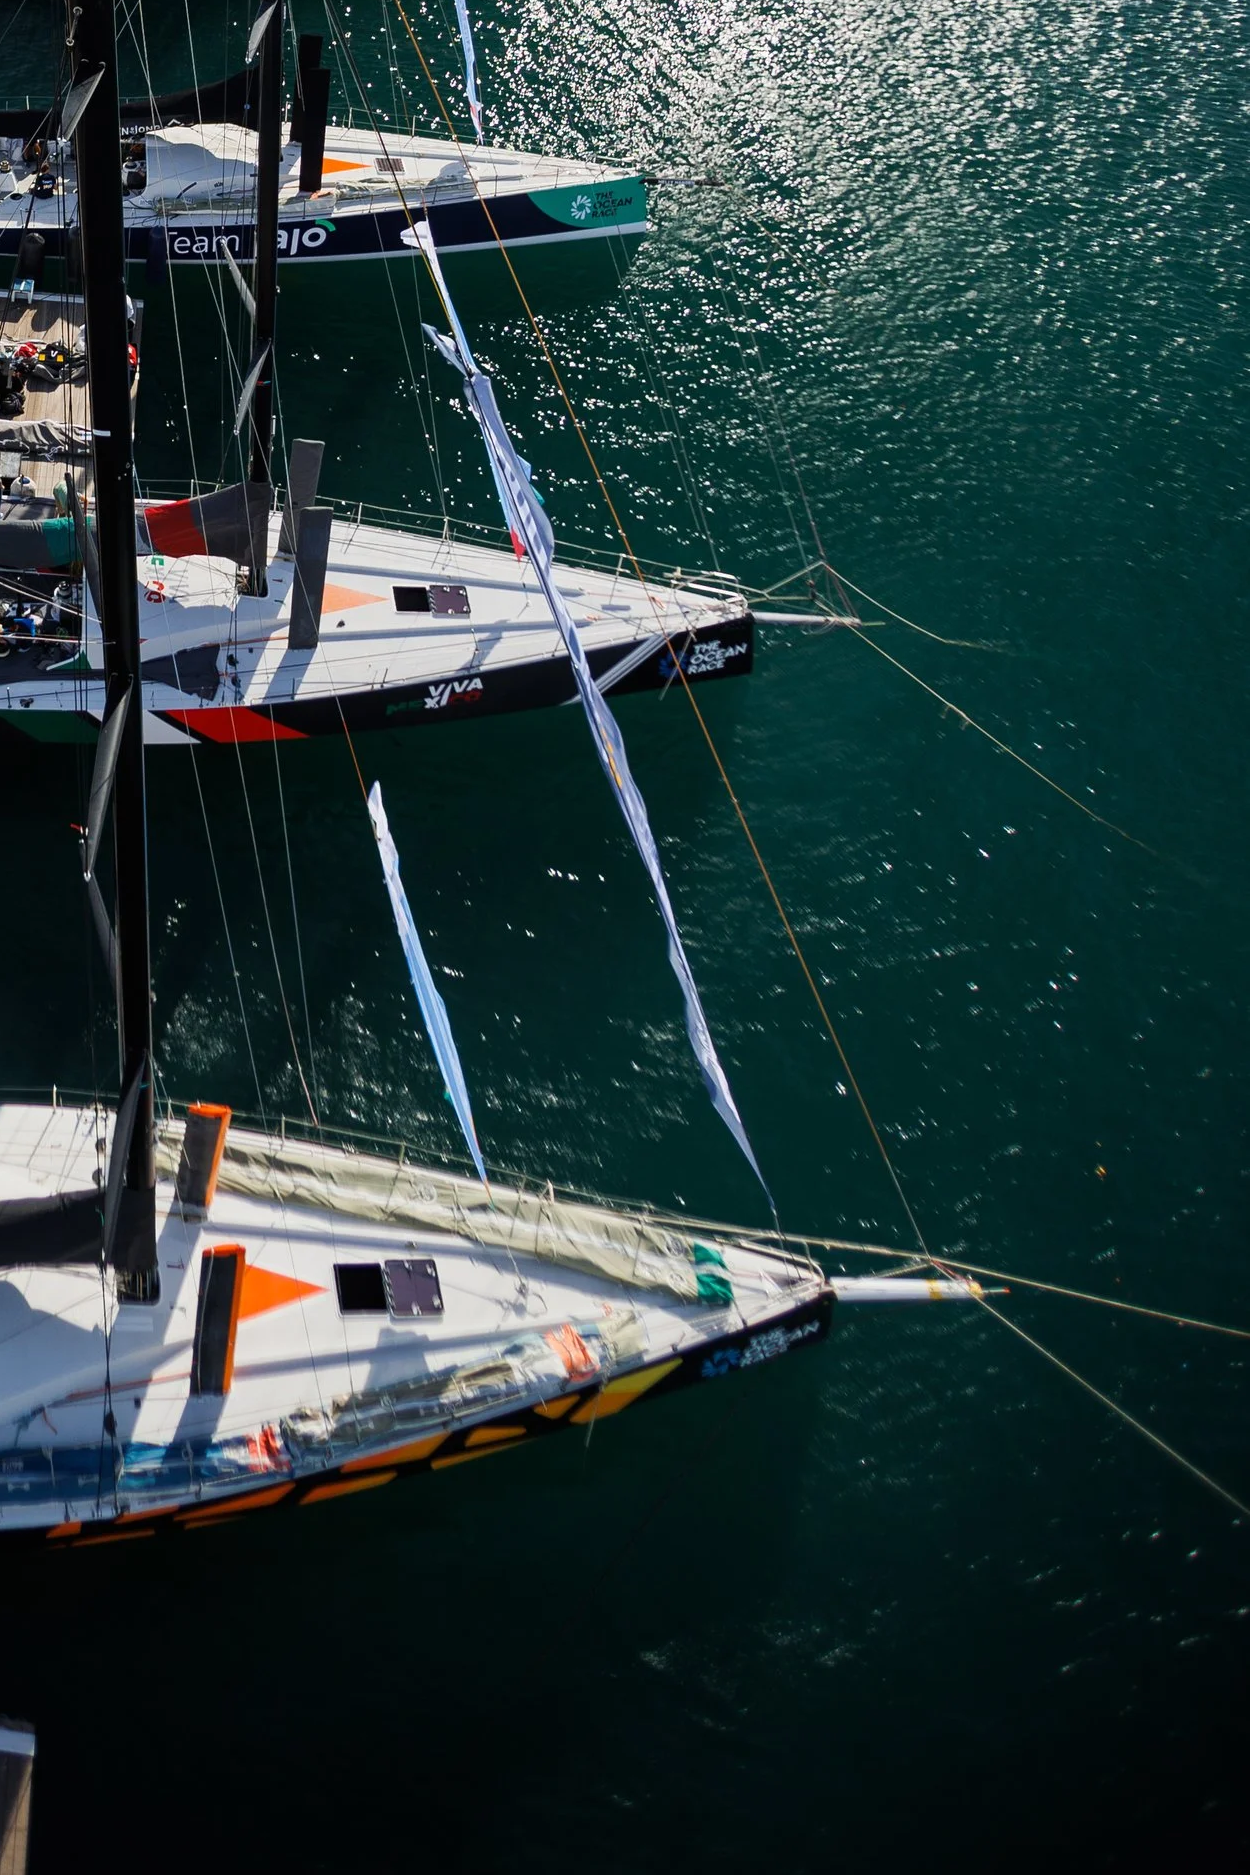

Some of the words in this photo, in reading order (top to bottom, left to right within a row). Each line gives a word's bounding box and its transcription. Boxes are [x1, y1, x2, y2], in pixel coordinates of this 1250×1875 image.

[593, 196, 633, 209] OCEAN
[595, 191, 614, 200] THE
[592, 207, 617, 218] RACE
[168, 230, 240, 254] Team
[690, 642, 748, 665] OCEAN
[693, 639, 721, 654] THE
[687, 658, 726, 675] RACE
[428, 677, 484, 698] VIVA
